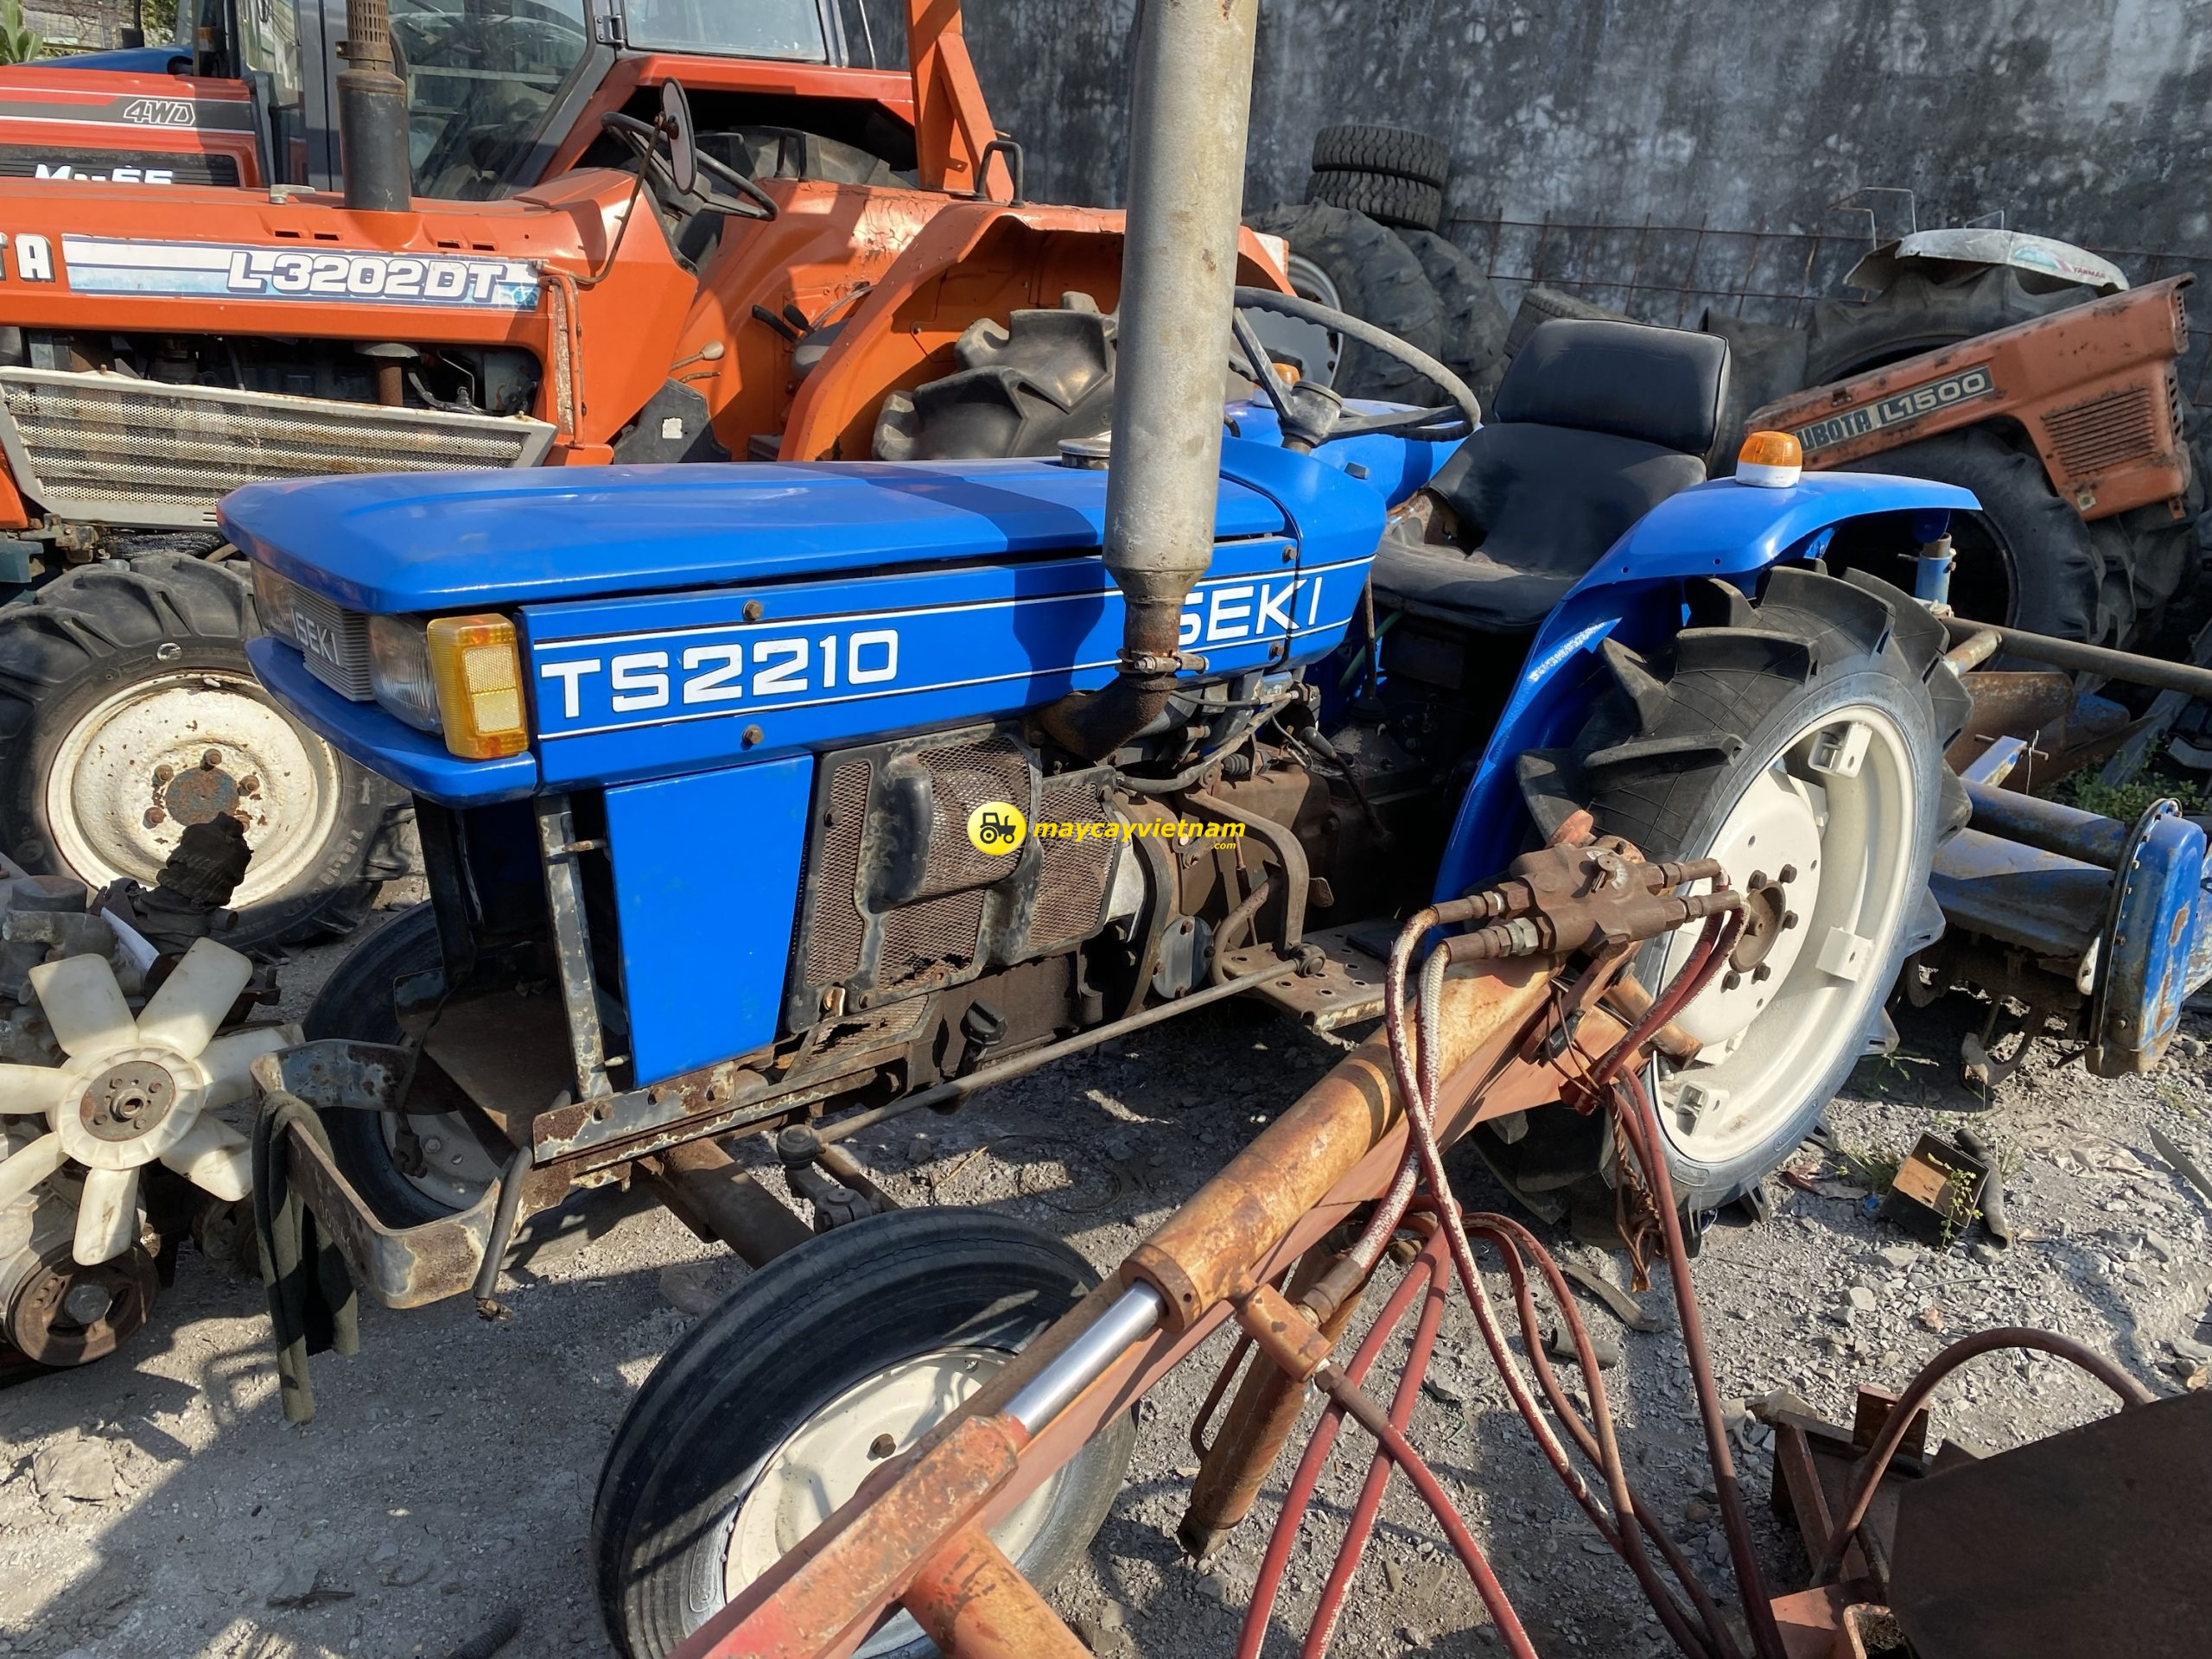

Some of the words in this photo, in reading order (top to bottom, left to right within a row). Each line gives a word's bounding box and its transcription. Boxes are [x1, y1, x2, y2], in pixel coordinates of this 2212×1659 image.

[123, 99, 196, 127] 4WD
[1796, 408, 1872, 451] UBOTA
[1884, 373, 1986, 421] L1500
[290, 607, 340, 666] ISEKI
[1178, 576, 1323, 646] SEKI
[540, 629, 899, 719] TS2210
